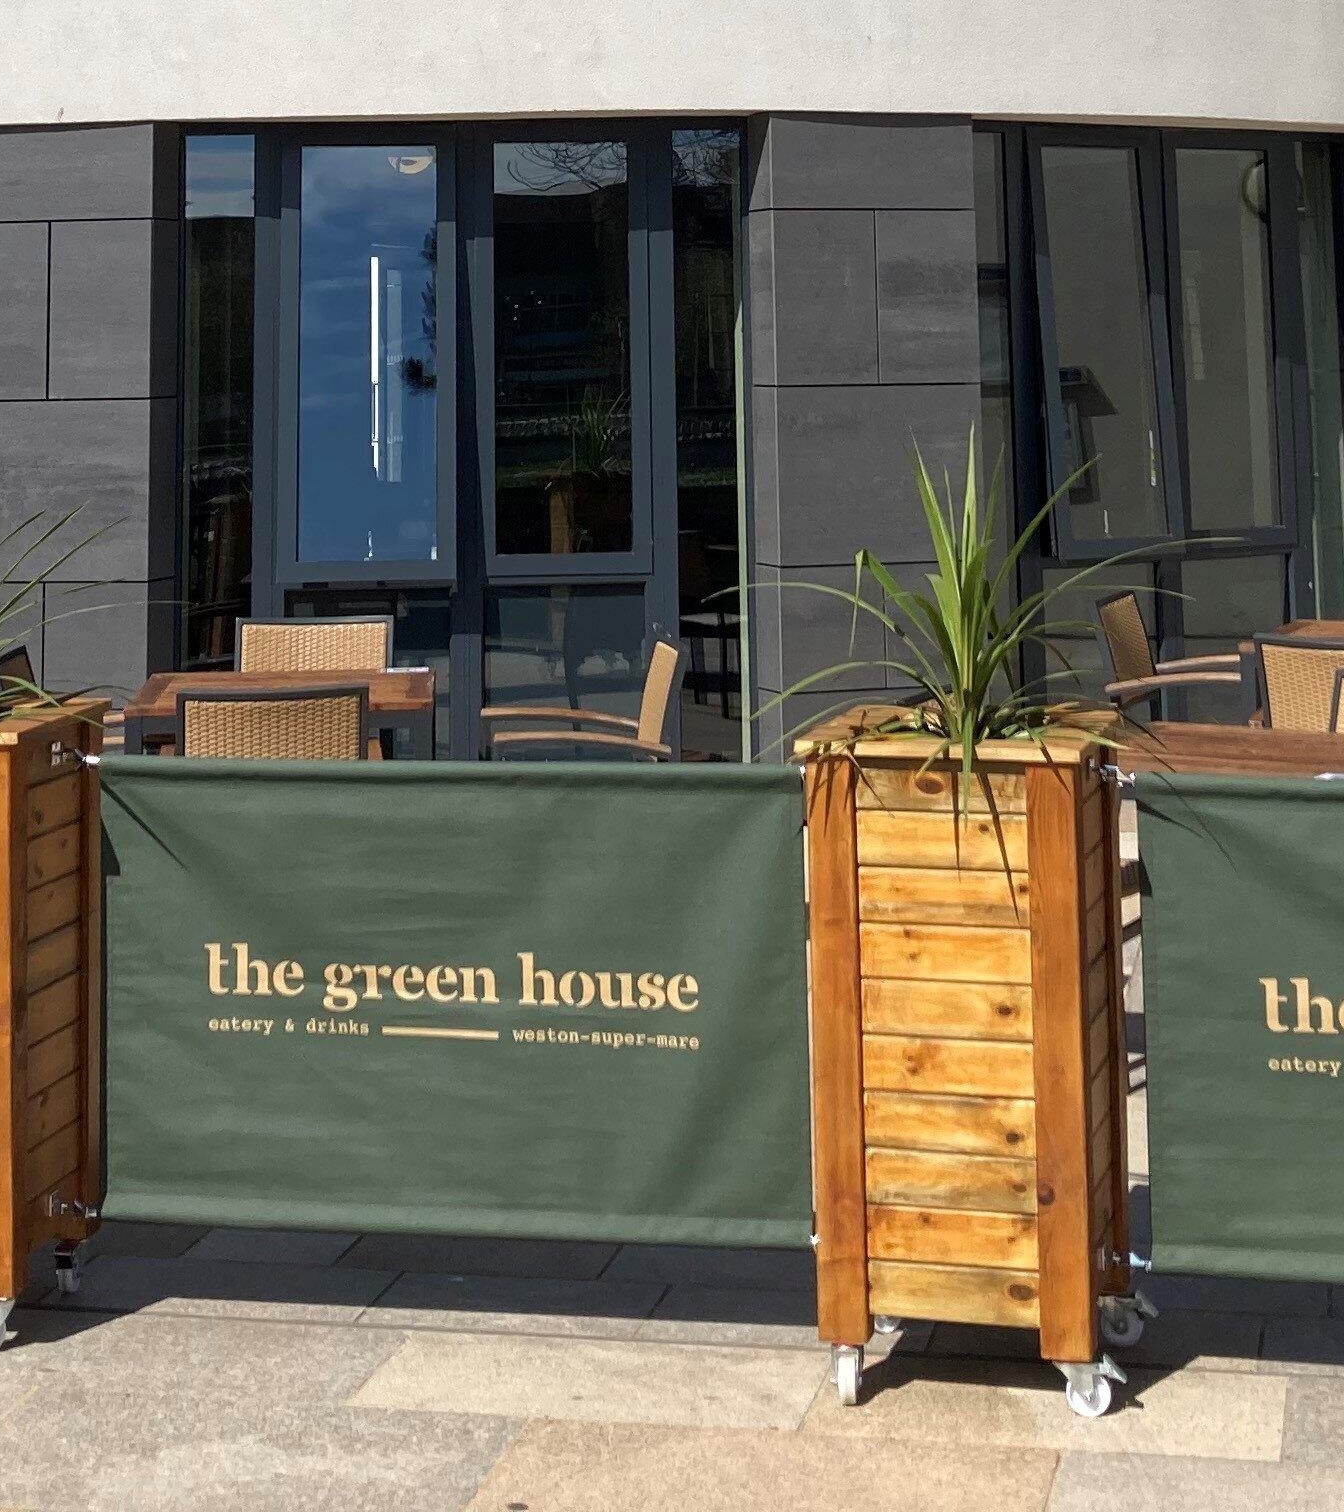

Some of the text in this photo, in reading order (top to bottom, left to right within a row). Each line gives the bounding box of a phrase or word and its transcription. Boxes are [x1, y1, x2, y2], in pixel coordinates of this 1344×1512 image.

[204, 941, 700, 1012] the green house
[208, 1016, 370, 1037] eatery & drinks
[511, 1026, 700, 1050] weston-super-mare
[1267, 1055, 1342, 1078] eatery
